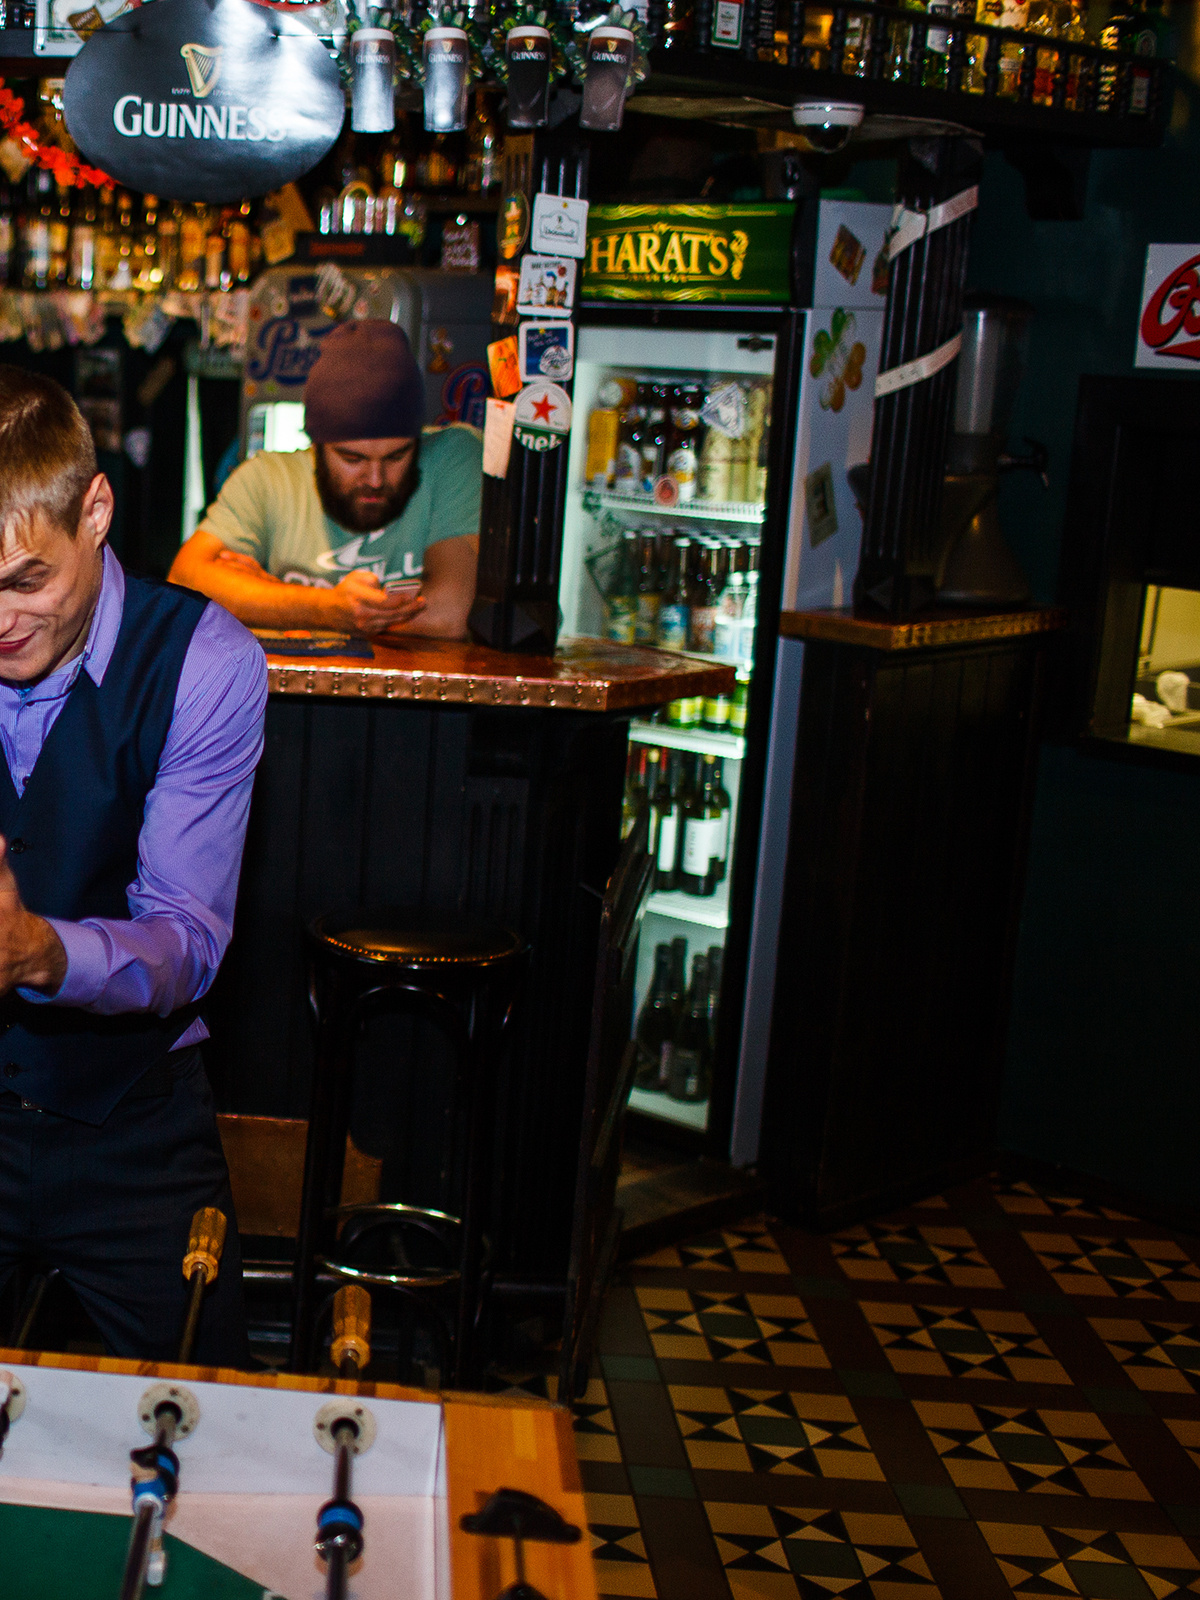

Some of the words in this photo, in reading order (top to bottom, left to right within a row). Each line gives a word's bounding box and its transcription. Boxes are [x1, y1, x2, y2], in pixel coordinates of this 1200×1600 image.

[510, 51, 546, 62] GUINNESS
[591, 52, 628, 64] GUINNESS
[112, 95, 287, 142] GUINNESS
